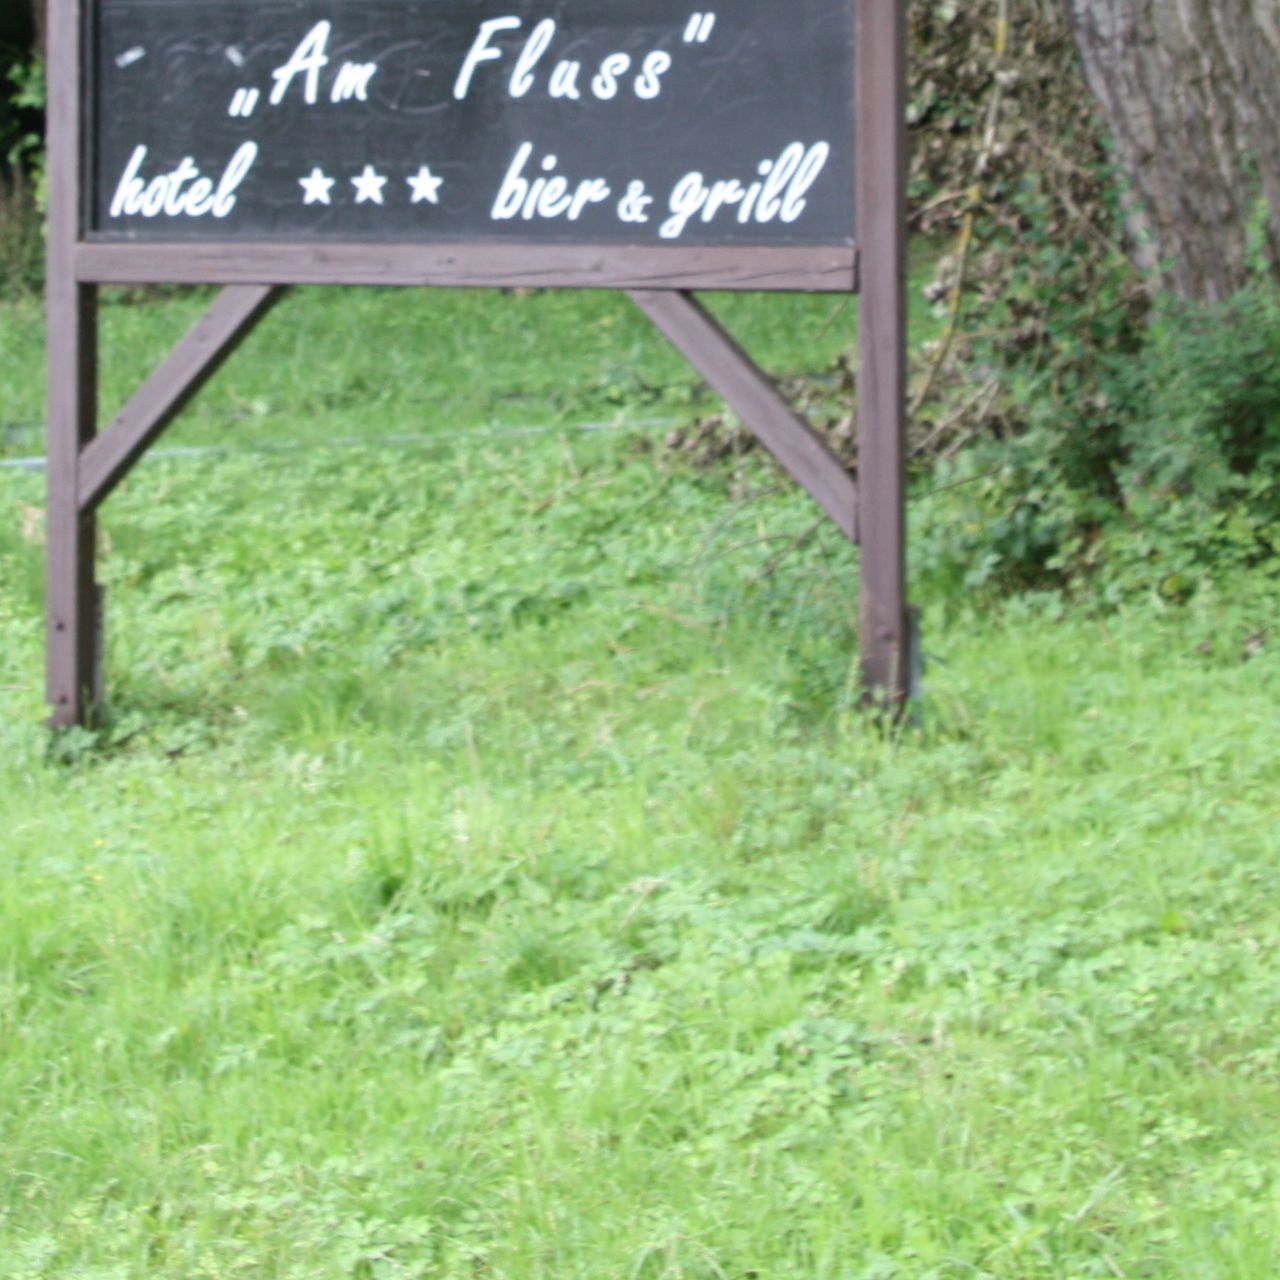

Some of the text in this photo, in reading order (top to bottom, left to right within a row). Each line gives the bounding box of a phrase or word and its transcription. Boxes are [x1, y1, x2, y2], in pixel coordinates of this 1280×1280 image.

[109, 140, 831, 240] hotel bier & grill
